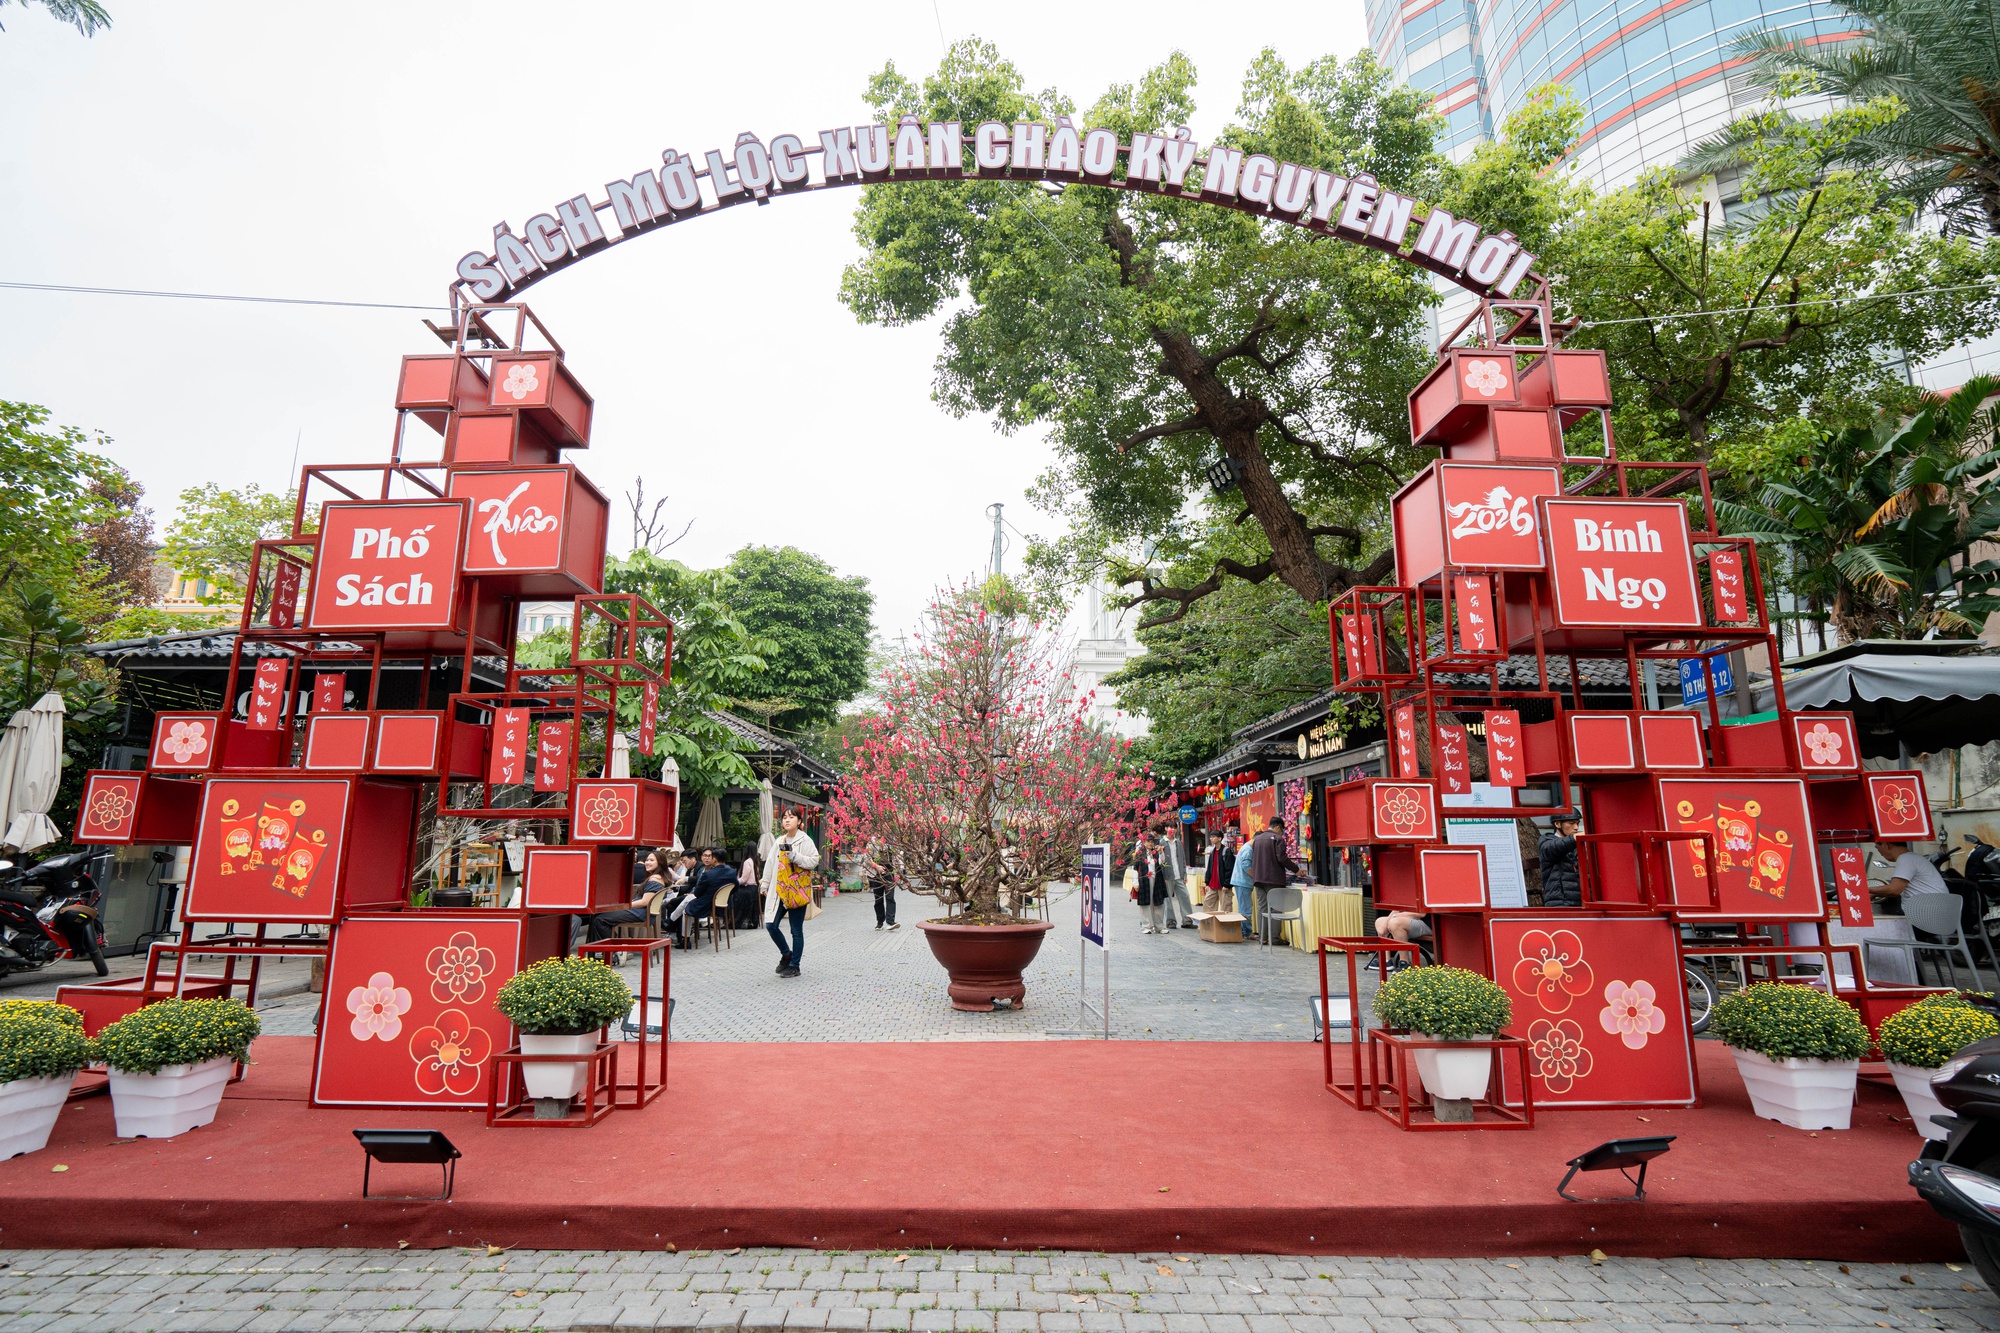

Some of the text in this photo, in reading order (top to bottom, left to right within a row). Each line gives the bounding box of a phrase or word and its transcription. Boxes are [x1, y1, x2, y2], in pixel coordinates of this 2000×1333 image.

[456, 114, 1537, 301] SÁCH MỞ LỘC XUÂN CHÀO KỶ NGUYÊN MỚI
[478, 481, 558, 566] Xuân
[1449, 496, 1535, 540] 2026
[350, 525, 436, 559] Phố
[1573, 519, 1664, 553] Bính
[1715, 554, 1735, 565] Chúc
[335, 573, 434, 607] Sách
[1581, 568, 1667, 610] Ngọ
[261, 662, 279, 672] Chúc
[1685, 681, 1694, 698] 19
[1718, 670, 1729, 687] 12
[543, 725, 562, 736] Chúc
[1491, 715, 1512, 726] Chúc
[1325, 737, 1343, 754] NAM
[1253, 779, 1269, 793] NAM
[228, 831, 250, 845] Phúc
[1837, 852, 1857, 863] Chúc
